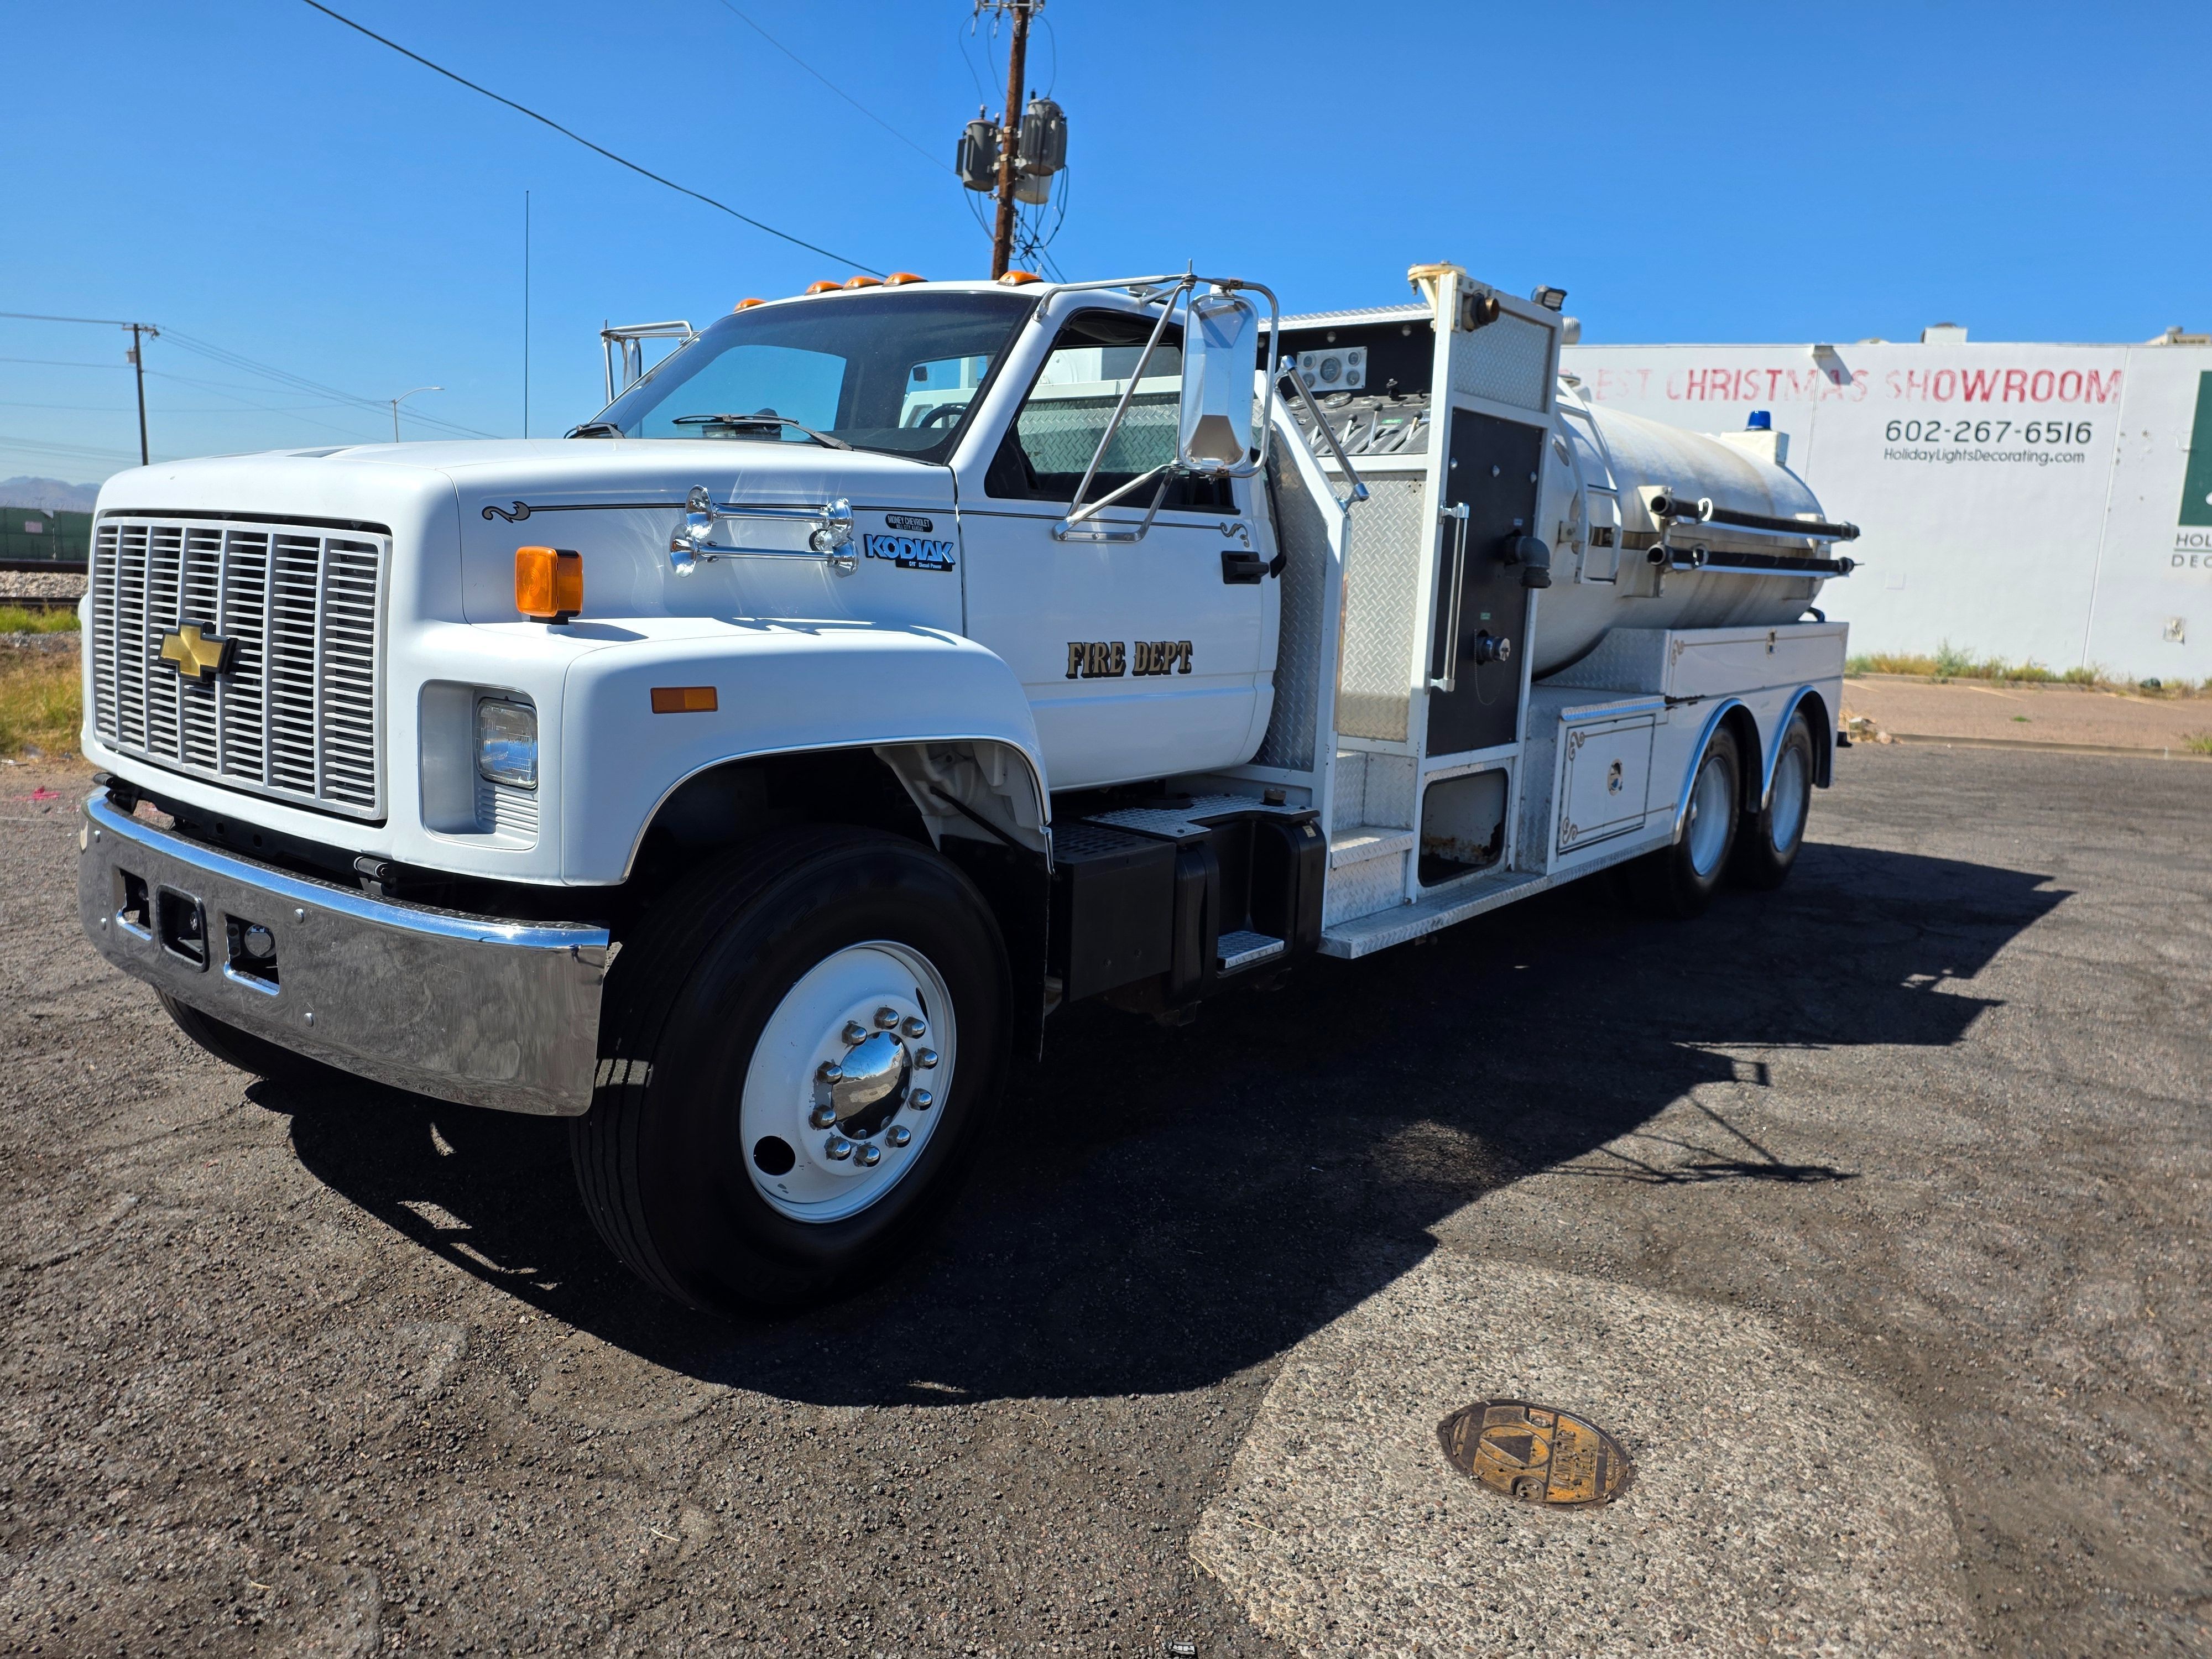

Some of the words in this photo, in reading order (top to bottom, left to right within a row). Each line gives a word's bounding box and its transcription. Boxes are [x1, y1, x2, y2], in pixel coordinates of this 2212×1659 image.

[1666, 369, 1869, 402] CHRISTMAS
[1886, 369, 2122, 403] SHOWROOM
[1886, 420, 2093, 444] 602-267-6516
[1884, 448, 2085, 466] HolidayLightsDecorating.com
[888, 515, 904, 524] MONEY
[905, 517, 930, 527] CHEVROLET
[864, 534, 956, 565] KODIAK
[1065, 641, 1126, 679] FIRE
